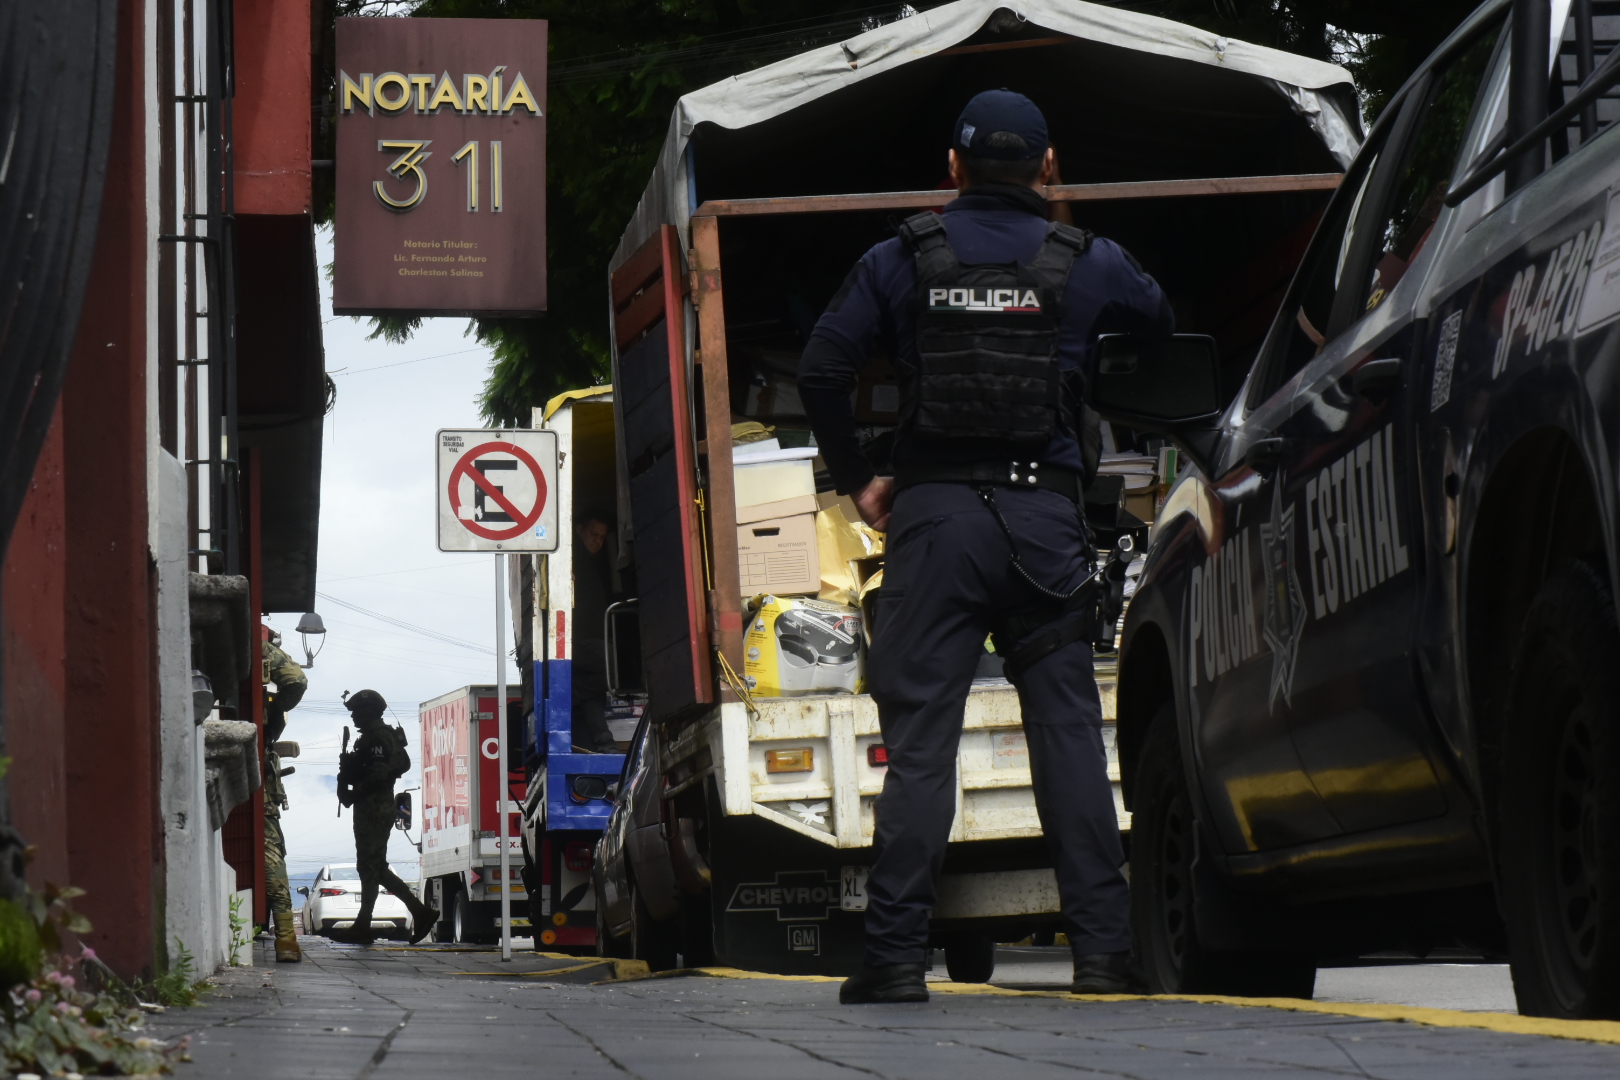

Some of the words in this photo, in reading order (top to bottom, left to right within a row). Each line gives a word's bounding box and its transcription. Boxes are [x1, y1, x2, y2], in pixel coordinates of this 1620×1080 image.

[341, 66, 542, 117] NOTARÍA
[403, 240, 440, 248] Notario
[443, 240, 478, 249] Titular:
[394, 254, 408, 262] Lic.
[411, 254, 455, 262] Fernando
[458, 255, 487, 263] Arturo
[398, 268, 448, 276] Charleston
[450, 268, 484, 277] Salinas
[929, 288, 1040, 307] POLICIA
[1306, 422, 1409, 620] ESTATAL
[739, 886, 840, 906] CHEVROL
[792, 929, 815, 946] GM
